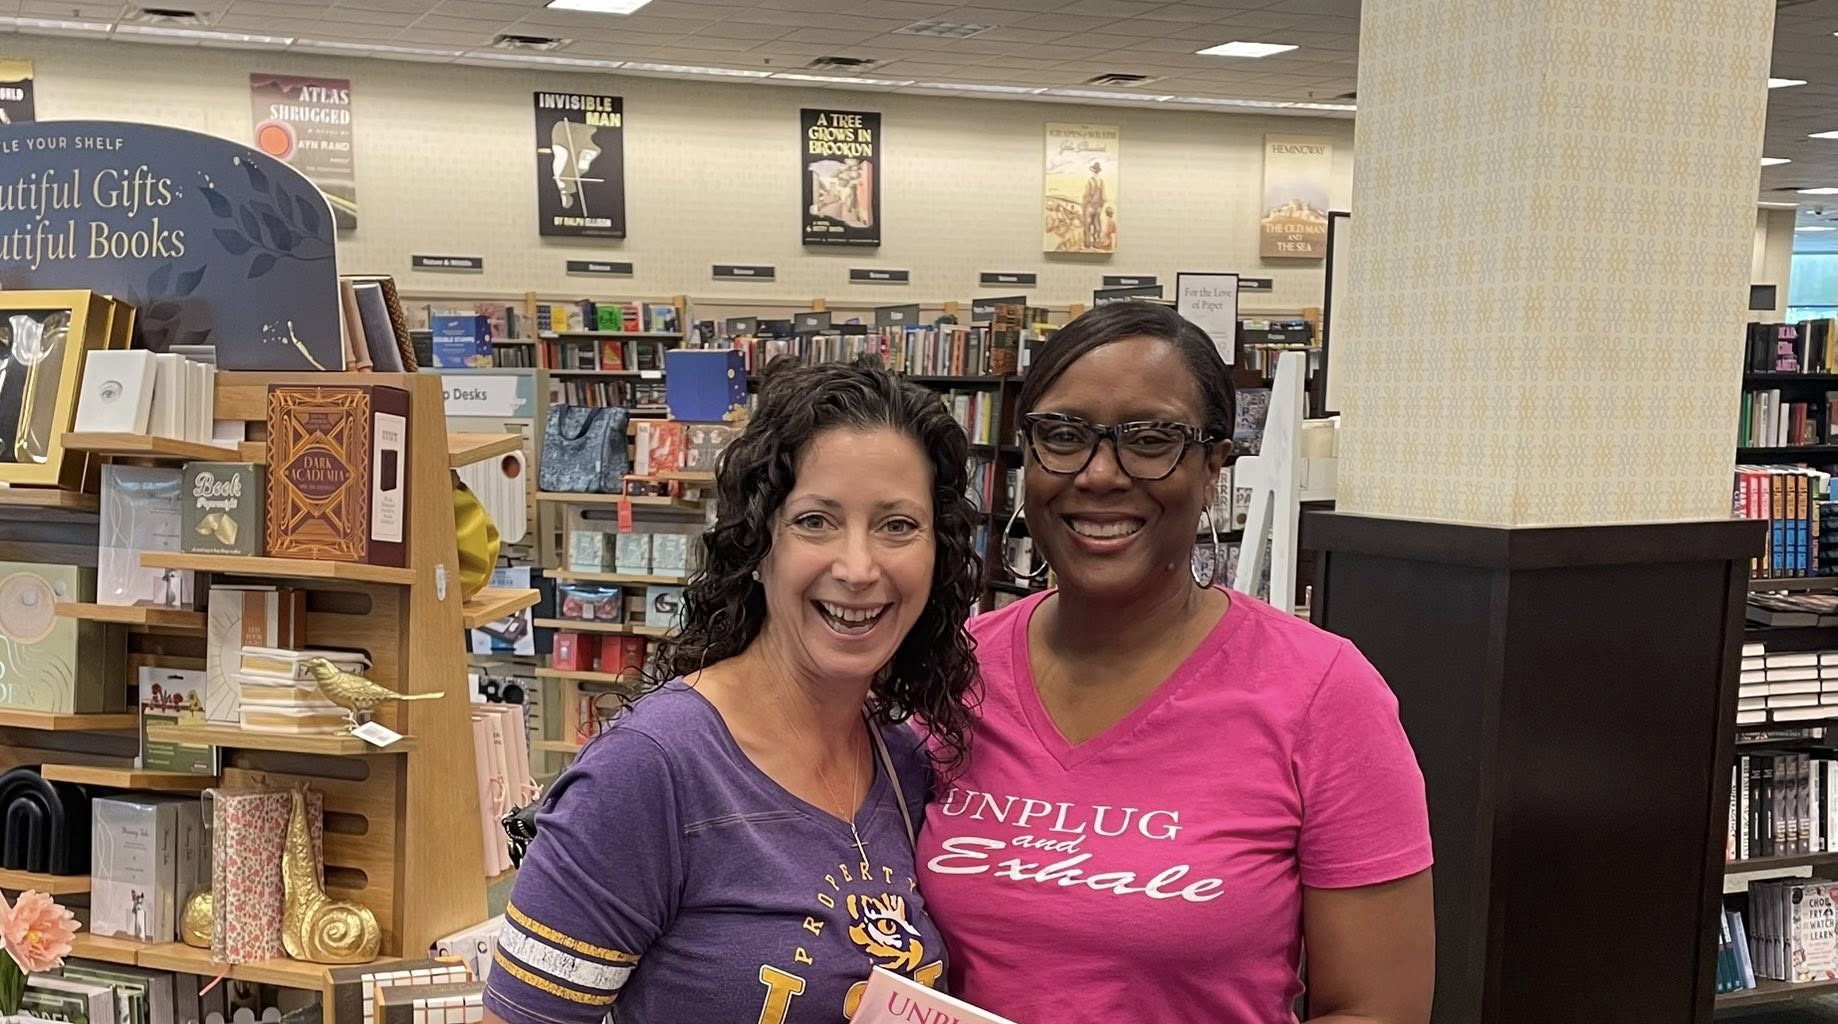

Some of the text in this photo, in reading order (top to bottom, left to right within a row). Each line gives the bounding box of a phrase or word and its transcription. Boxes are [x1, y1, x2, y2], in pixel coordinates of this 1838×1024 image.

[299, 86, 350, 105] ATLAS
[538, 93, 612, 111] INVISIBLE
[270, 104, 350, 125] SHRUGGED
[585, 112, 621, 127] MAN
[817, 113, 863, 128] A TREE
[808, 126, 871, 143] GROWS IN
[26, 137, 67, 150] YOUR
[75, 136, 124, 150] SHELF
[298, 139, 350, 151] AYN RAND
[1272, 144, 1326, 155] HEMINGWAY
[92, 165, 172, 217] Gifts
[1266, 223, 1282, 233] THE
[88, 217, 185, 259] Books
[1276, 241, 1295, 251] THE
[453, 388, 487, 400] Desks
[303, 455, 331, 469] DARK
[291, 469, 345, 482] ACADEMIA
[193, 471, 242, 497] Book
[941, 787, 1183, 841] UNPLUG
[1011, 833, 1087, 855] and
[927, 835, 1225, 903] Exhale
